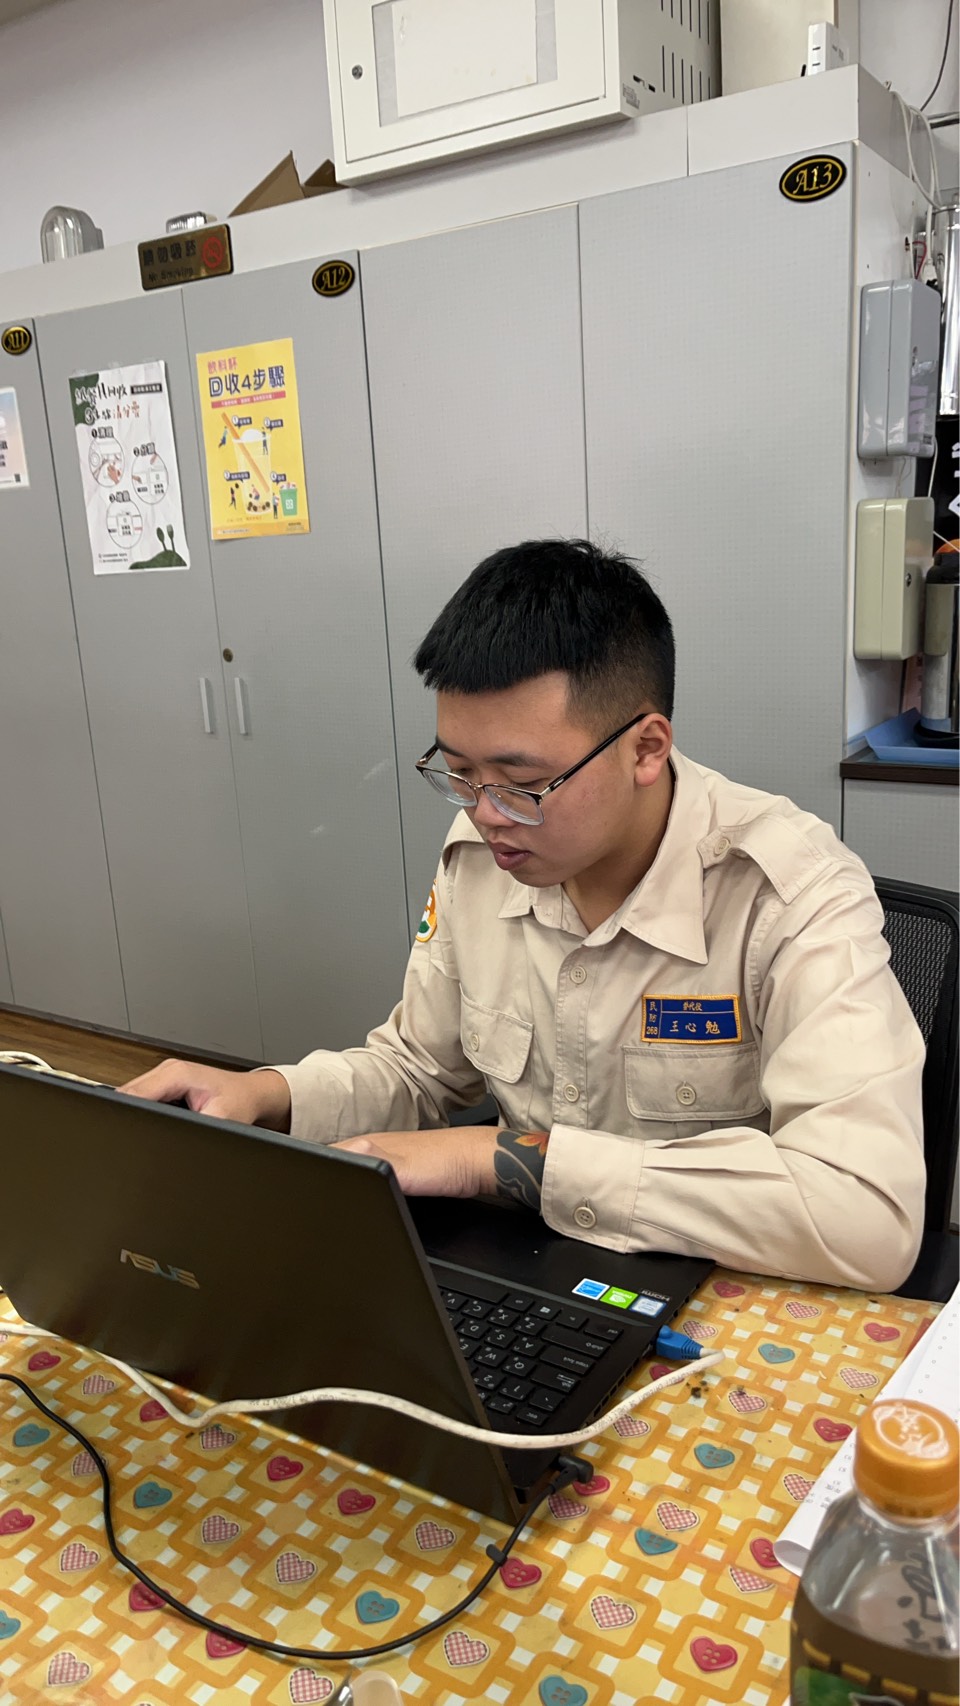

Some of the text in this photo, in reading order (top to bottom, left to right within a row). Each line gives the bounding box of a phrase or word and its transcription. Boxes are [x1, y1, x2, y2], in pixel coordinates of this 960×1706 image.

[792, 163, 833, 195] A13
[320, 266, 347, 291] A12
[207, 356, 238, 375] 飲料杯
[682, 1001, 703, 1012] 替代役
[669, 1020, 721, 1035] 王心勉
[120, 1248, 200, 1289] ASUS
